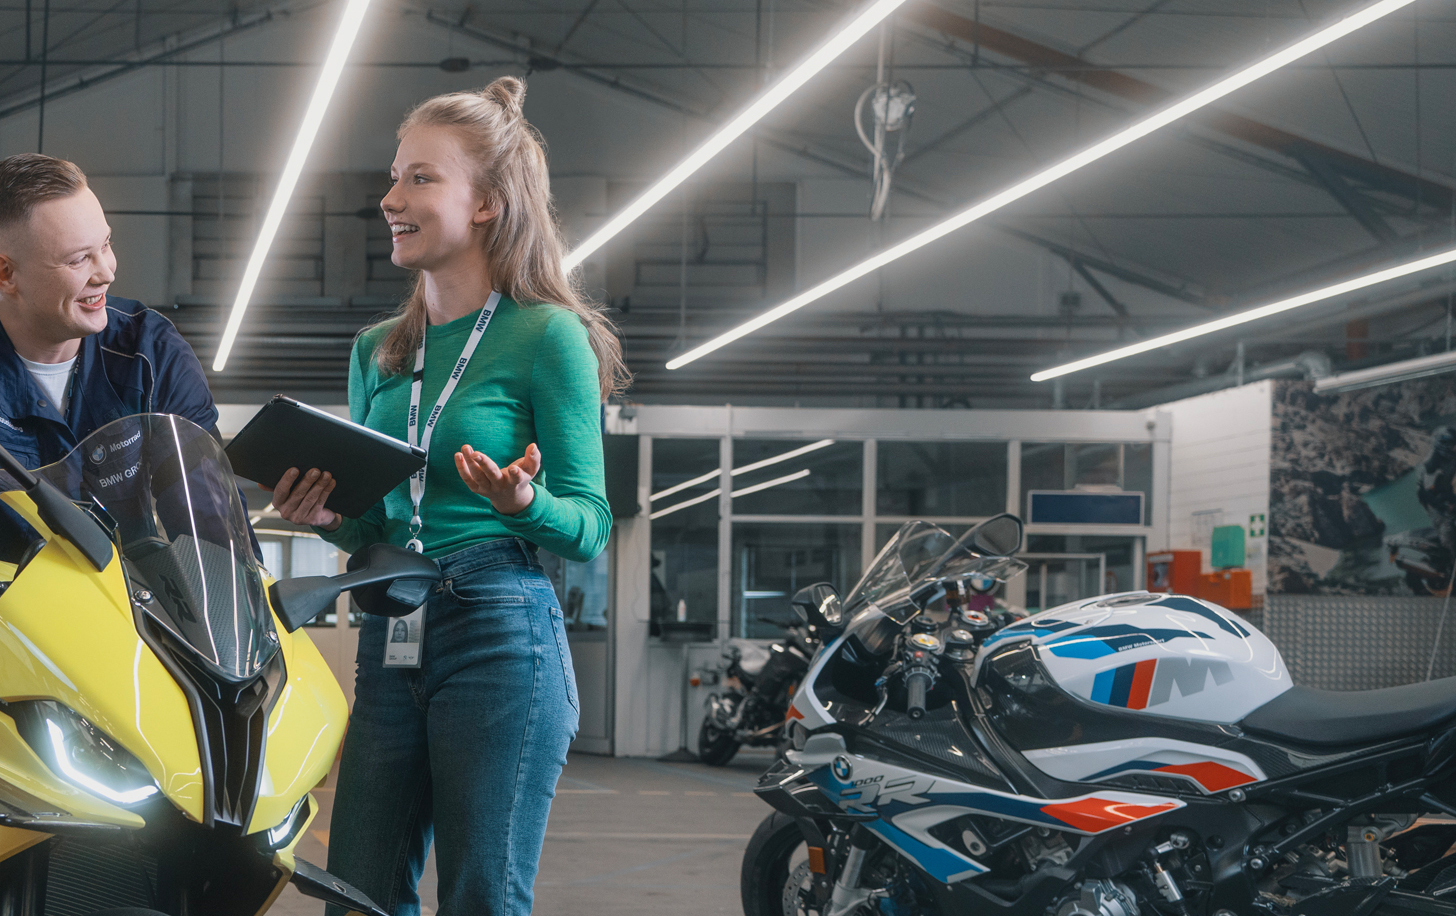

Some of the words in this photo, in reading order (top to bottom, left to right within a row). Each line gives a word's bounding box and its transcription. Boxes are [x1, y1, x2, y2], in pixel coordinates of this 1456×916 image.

[475, 309, 492, 333] BMW
[451, 357, 468, 380] BMW
[409, 404, 418, 427] BMW
[427, 405, 442, 428] BMW
[109, 430, 141, 453] Motorrad
[99, 472, 124, 488] BMW
[158, 574, 197, 624] RR
[1149, 657, 1235, 708] M
[850, 775, 885, 788] 1000
[838, 775, 937, 815] RR
